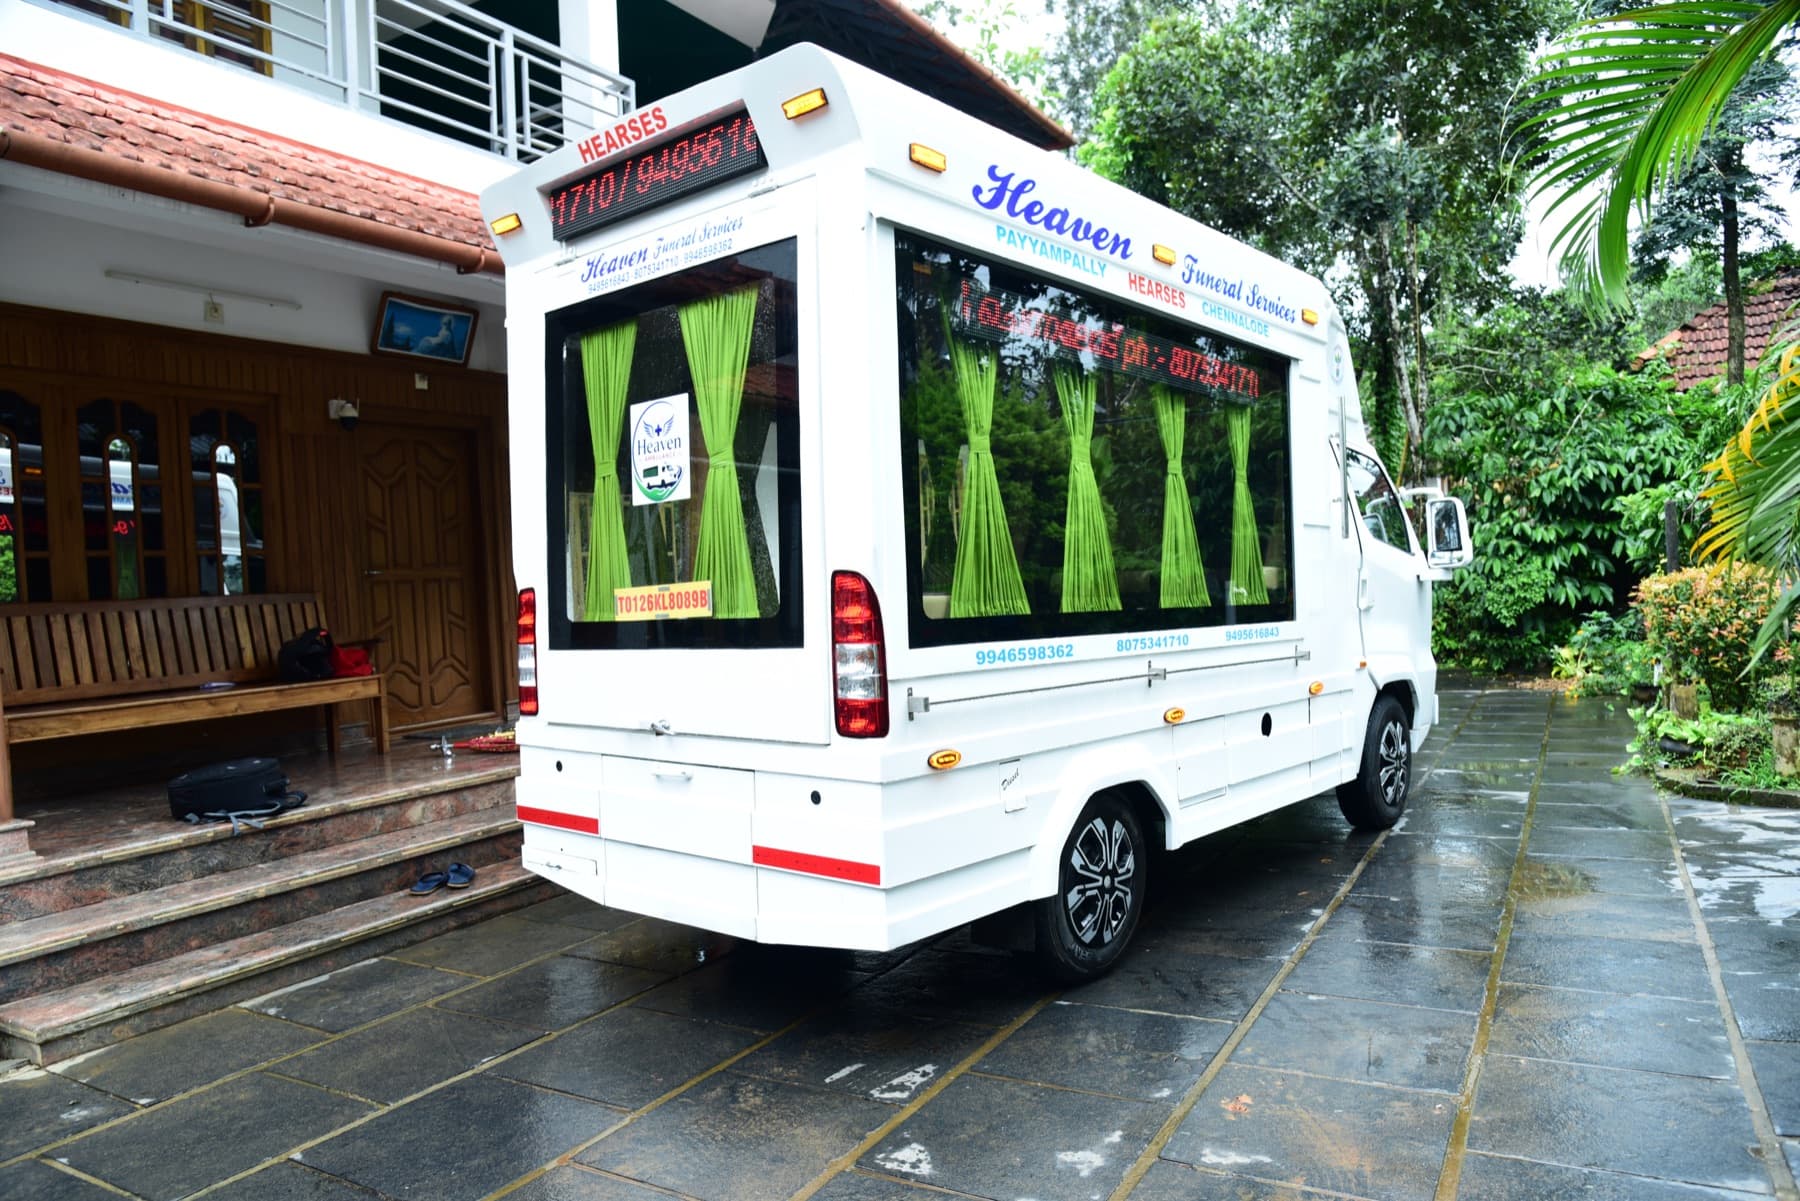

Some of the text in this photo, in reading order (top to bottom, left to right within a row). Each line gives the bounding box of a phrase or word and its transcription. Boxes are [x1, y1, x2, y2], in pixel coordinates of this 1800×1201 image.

[577, 106, 667, 163] HEARSES
[972, 164, 1133, 261] Heaven
[581, 216, 743, 283] Heaven Funeral Services
[996, 224, 1270, 338] PAYYAMPALLY HEARSES CHENNALODE
[1181, 253, 1297, 324] Funeral Services
[637, 436, 682, 456] Heaven
[618, 590, 708, 613] T0126KL8089B
[976, 626, 1280, 665] 9946598362 8075341710 9495616843
[1001, 767, 1019, 791] Diesel
